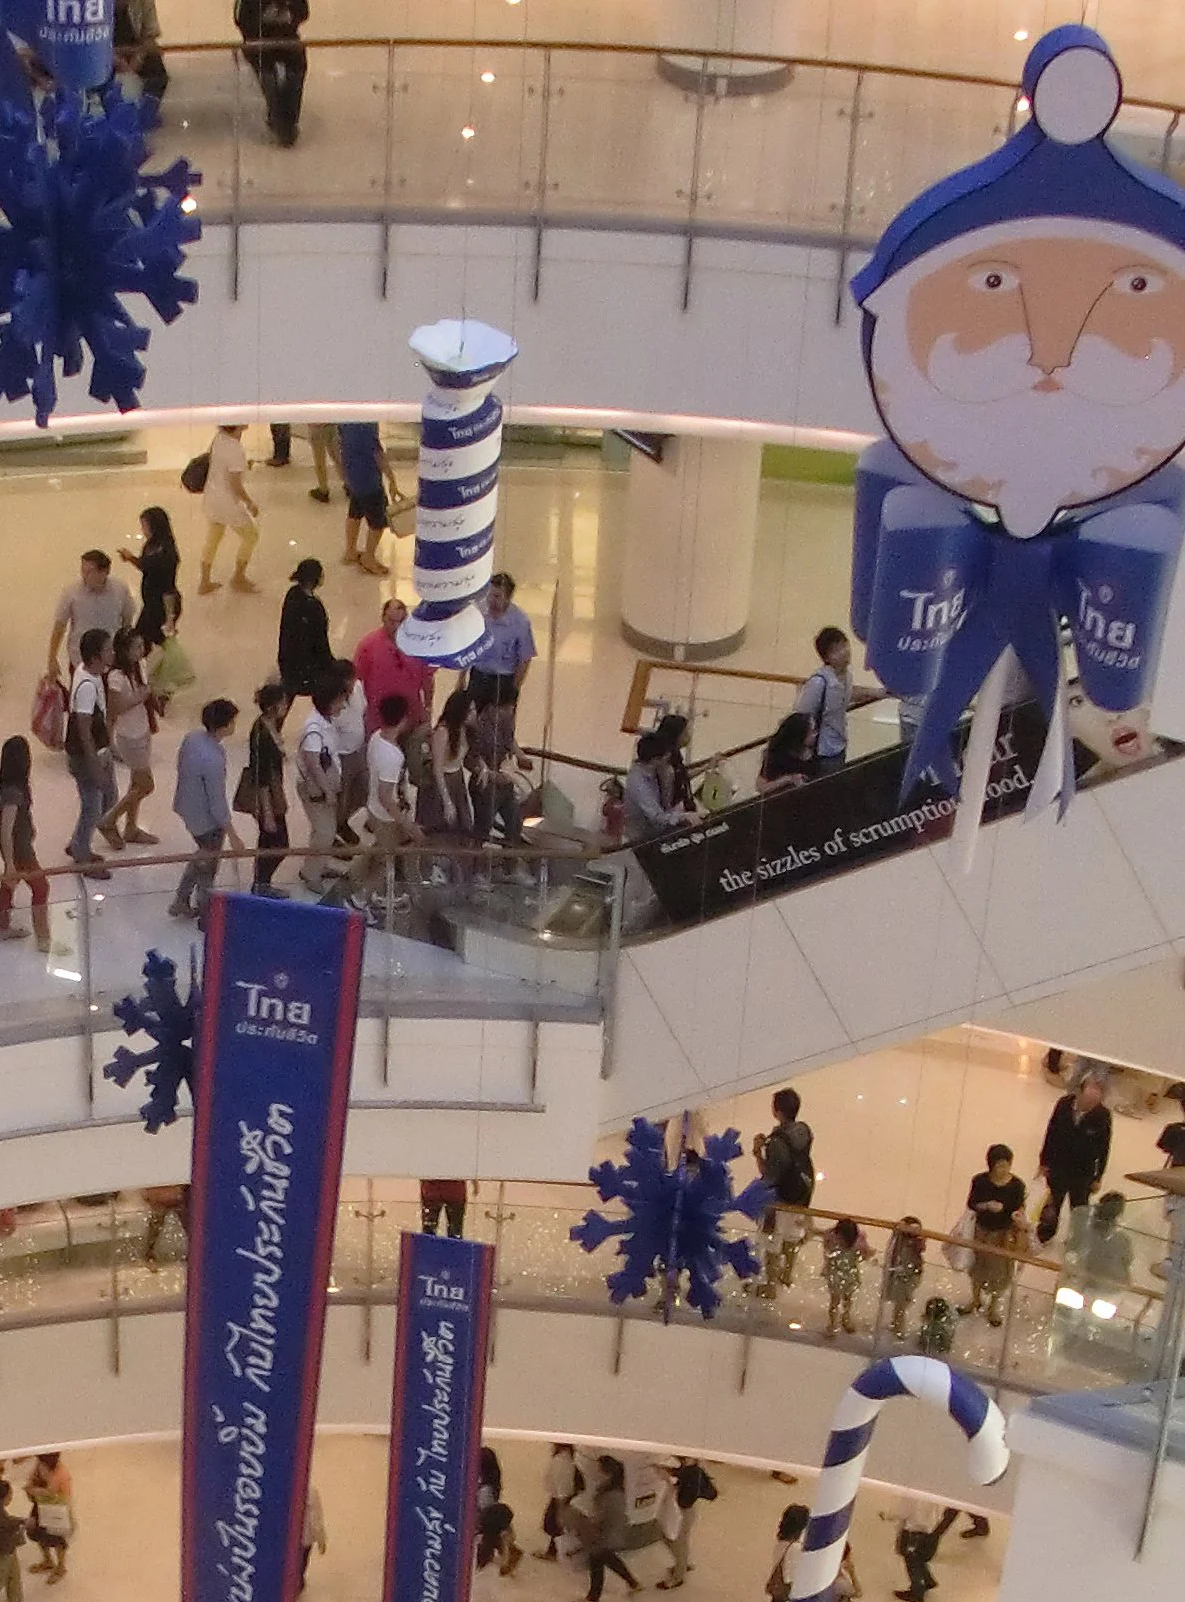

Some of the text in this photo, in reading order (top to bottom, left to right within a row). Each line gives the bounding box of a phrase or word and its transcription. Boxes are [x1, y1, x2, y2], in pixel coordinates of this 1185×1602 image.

[719, 868, 755, 892] the
[756, 845, 822, 880] sizzles
[823, 828, 848, 855] of
[985, 764, 1035, 801] ood.
[235, 980, 312, 1026] ไทย
[418, 1275, 465, 1300] ไทย
